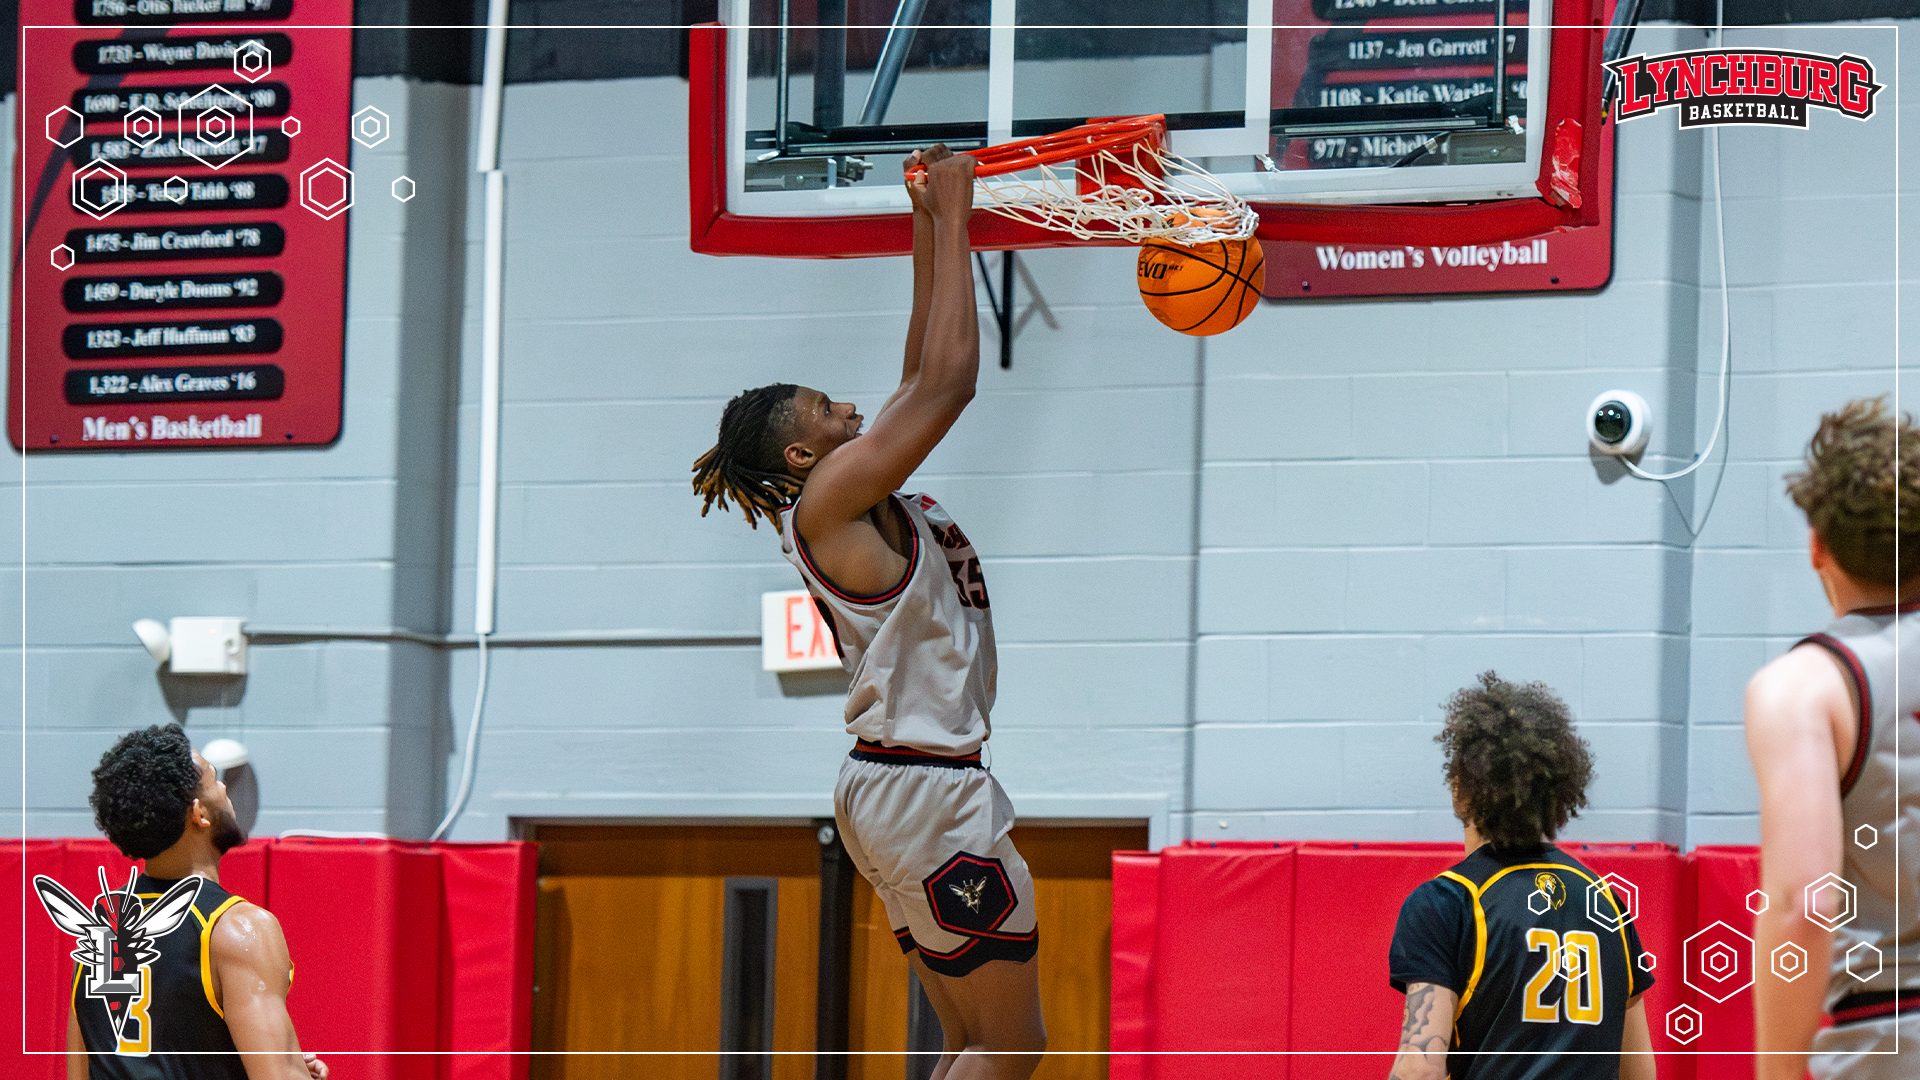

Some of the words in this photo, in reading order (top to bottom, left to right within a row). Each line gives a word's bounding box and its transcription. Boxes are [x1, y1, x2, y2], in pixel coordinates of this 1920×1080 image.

[144, 42, 195, 65] Wayne
[1348, 41, 1384, 60] 1137
[1396, 39, 1426, 59] Jen
[1428, 37, 1488, 57] Garrett
[1320, 87, 1361, 107] 1108
[1377, 85, 1428, 105] Katie
[1314, 139, 1346, 159] 977
[130, 232, 161, 251] Jim
[161, 229, 234, 250] Crawford
[1316, 244, 1425, 271] Women's
[1430, 239, 1549, 271] Volleyball
[1138, 261, 1168, 279] EVO
[131, 327, 163, 348] Jeff
[164, 326, 230, 347] Huffman
[138, 374, 174, 394] Alex
[174, 372, 230, 394] Graves
[231, 371, 257, 391] '16
[83, 415, 148, 442] Men's
[151, 414, 263, 440] Basketball
[1521, 926, 1603, 1026] 20
